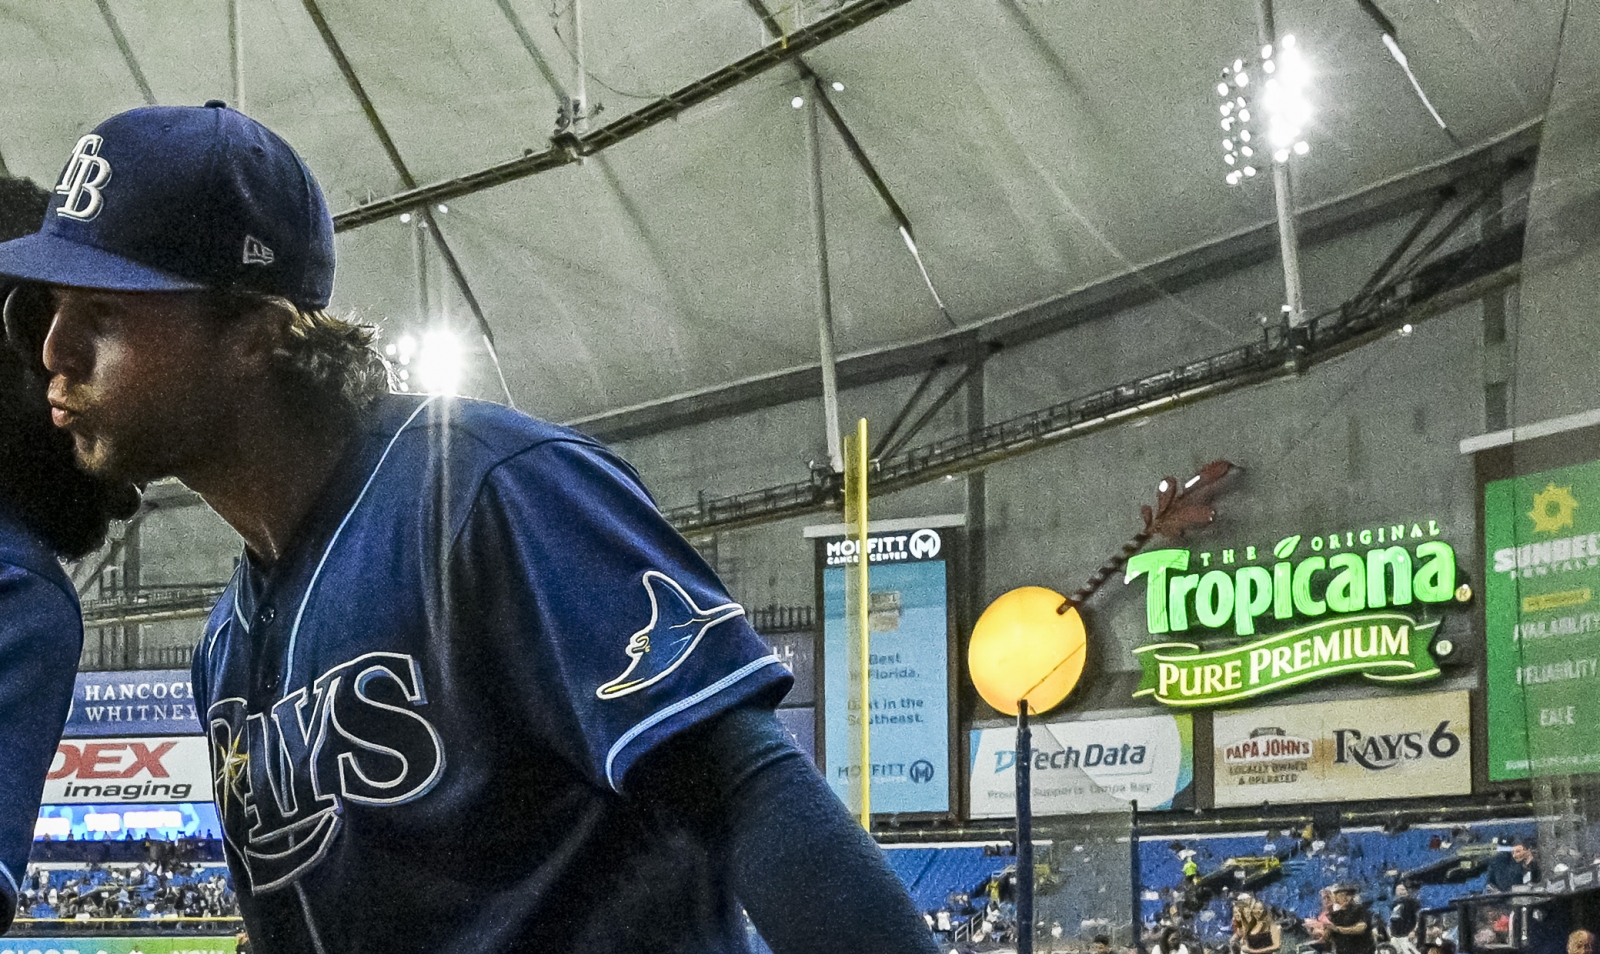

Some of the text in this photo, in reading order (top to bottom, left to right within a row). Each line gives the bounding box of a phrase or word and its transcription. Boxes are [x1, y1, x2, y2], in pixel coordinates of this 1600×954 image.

[826, 535, 908, 557] MOFITT
[1201, 520, 1441, 567] THE ORIGINAL
[826, 555, 860, 565] CANCE
[1124, 540, 1456, 636] Tropicana
[1158, 624, 1410, 696] PURE PREMIUM
[1083, 743, 1146, 768] Data
[1226, 741, 1259, 759] PAPA
[1333, 720, 1461, 771] RAYS 6
[838, 763, 905, 777] MOFITT
[64, 781, 192, 799] imaging
